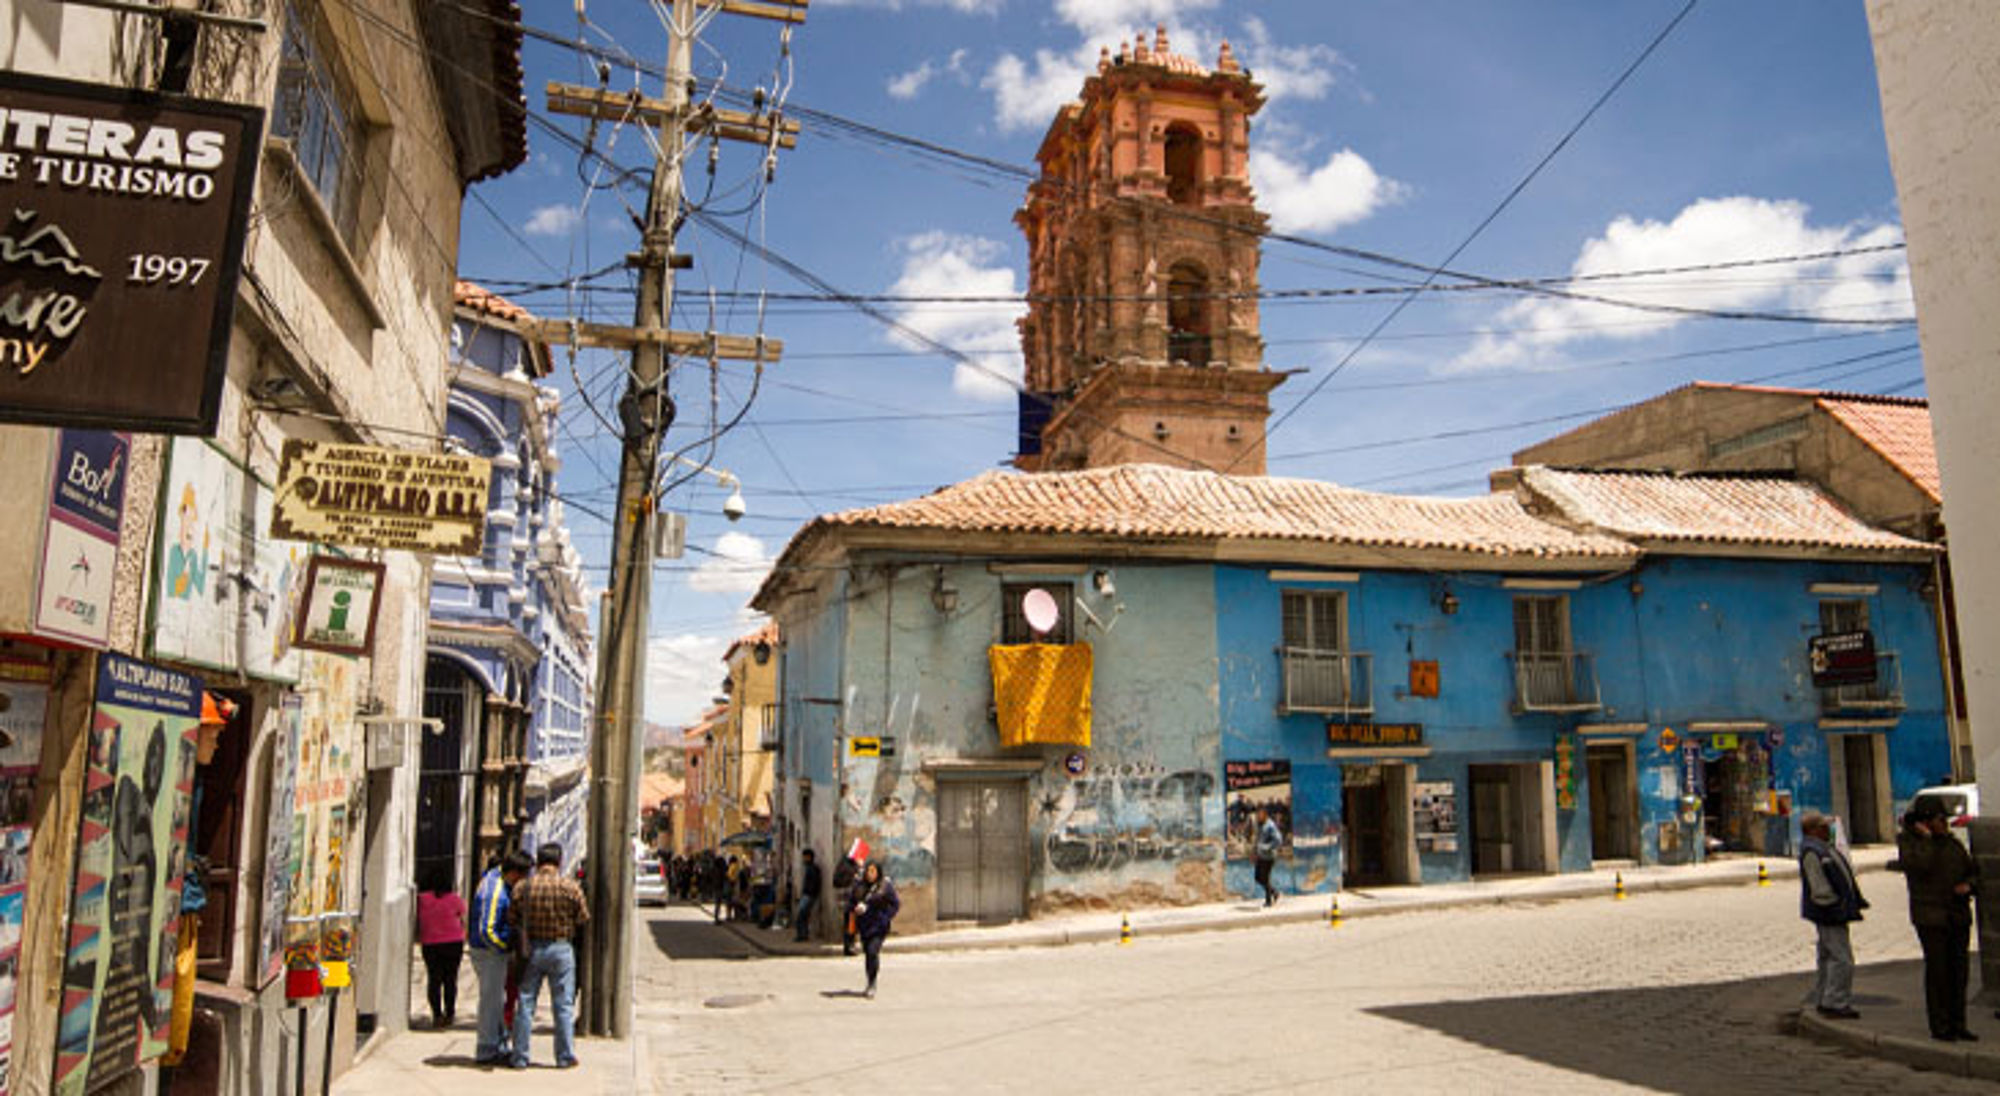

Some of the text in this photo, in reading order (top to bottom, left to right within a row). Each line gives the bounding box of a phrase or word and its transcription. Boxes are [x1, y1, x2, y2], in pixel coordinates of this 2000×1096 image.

[0, 106, 226, 169] TERAS
[33, 156, 214, 199] TURISMO
[127, 252, 212, 287] 1997
[316, 463, 382, 481] TURISMO
[386, 470, 406, 483] DE
[410, 473, 486, 490] AVENTURA
[325, 448, 470, 472] AGENCIA DE VIAJES
[316, 480, 430, 515] ALTIPLANO
